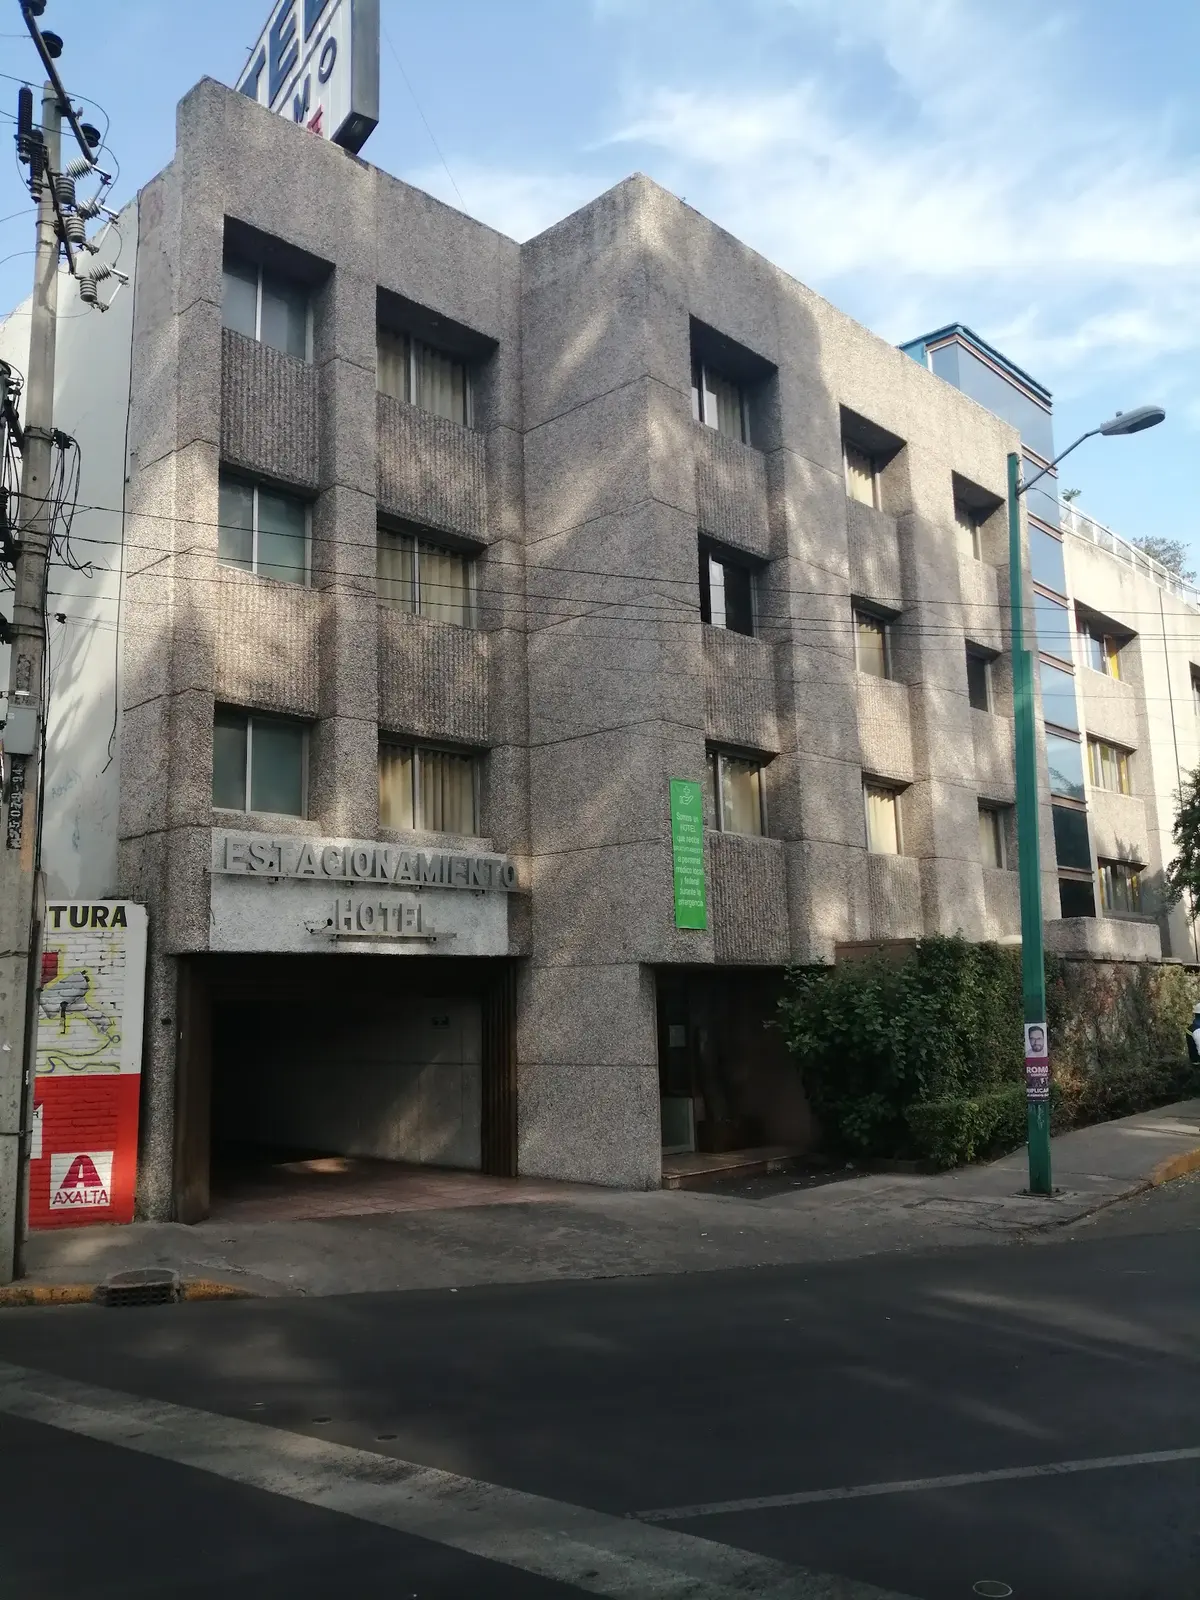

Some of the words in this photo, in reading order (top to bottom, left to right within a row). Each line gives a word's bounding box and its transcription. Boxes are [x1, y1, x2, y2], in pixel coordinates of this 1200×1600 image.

[679, 823, 696, 833] HOTEL
[224, 837, 518, 888] ESTACIONAMIENTO
[49, 906, 127, 928] TURA
[332, 899, 436, 933] HOTEL
[52, 1190, 108, 1204] AXALTA
